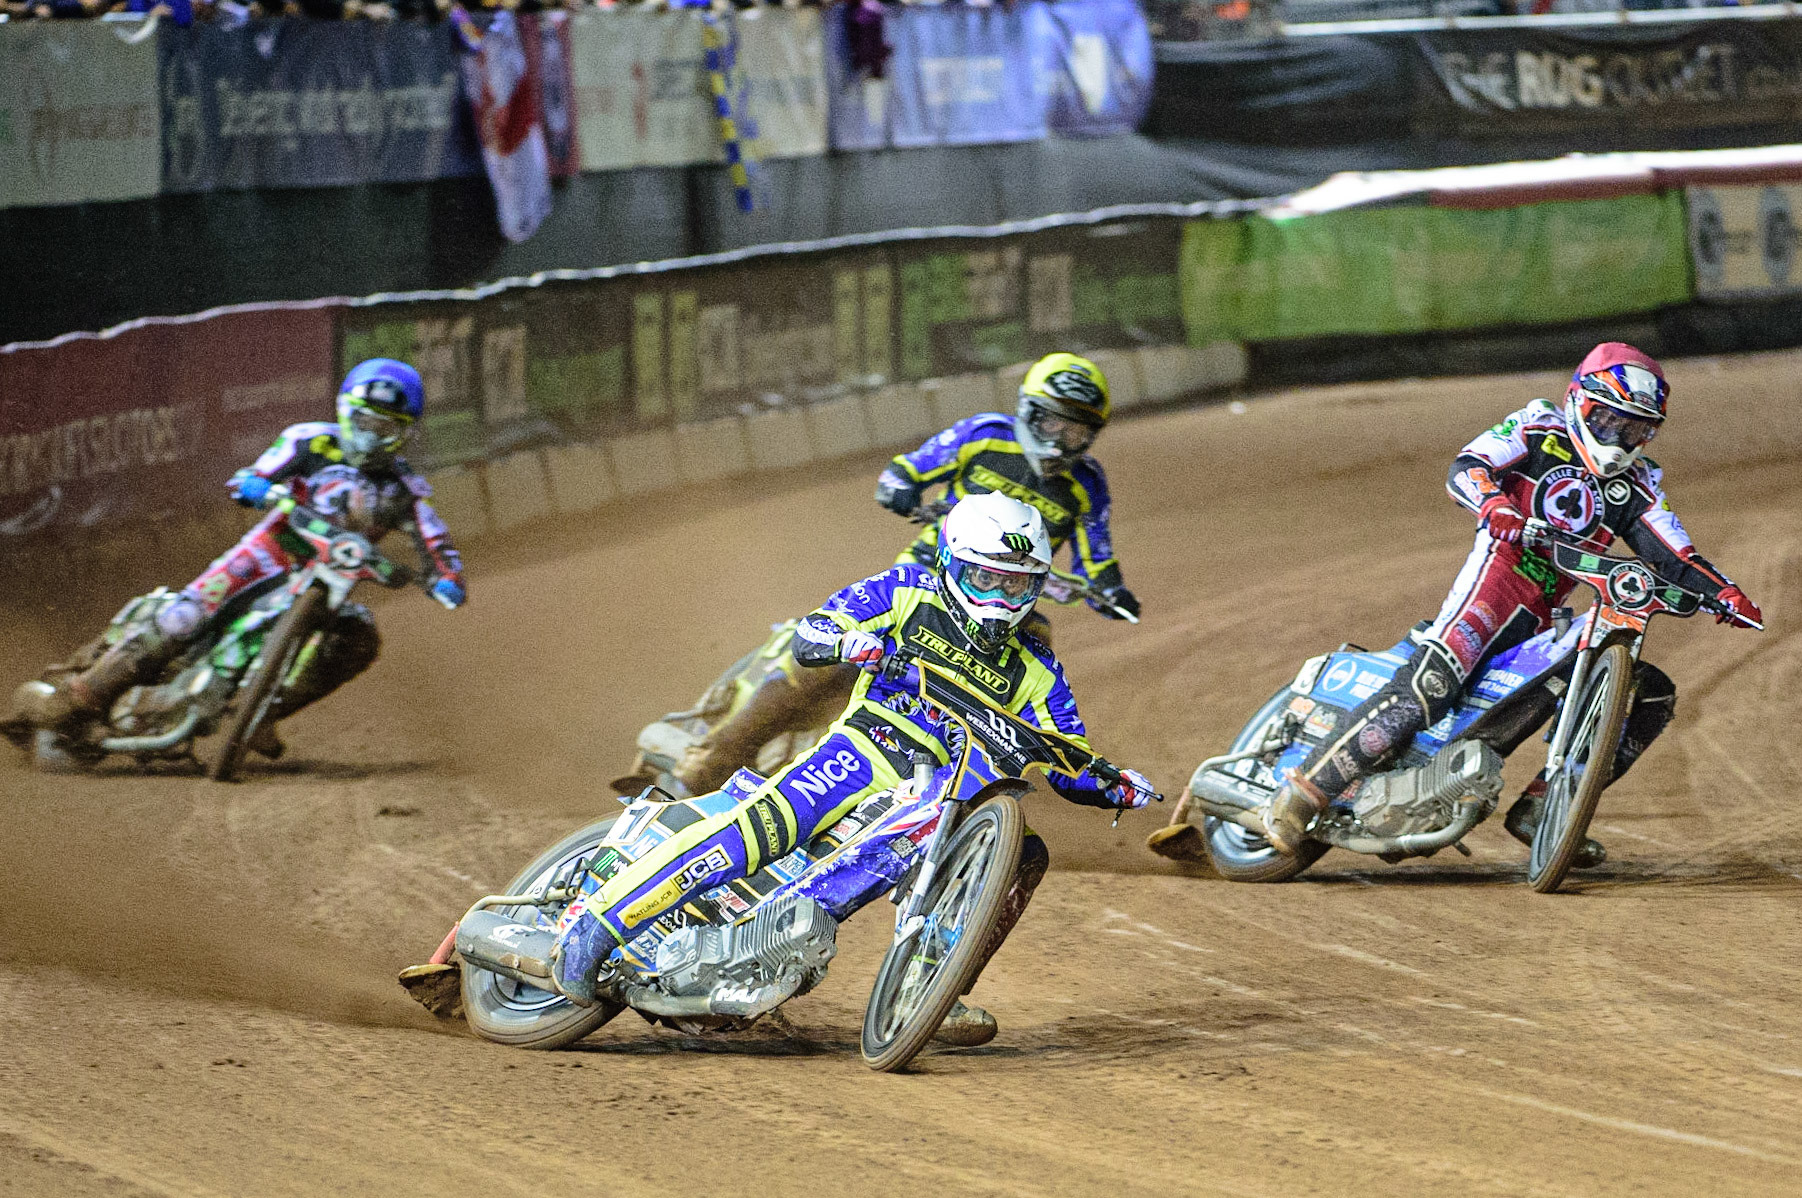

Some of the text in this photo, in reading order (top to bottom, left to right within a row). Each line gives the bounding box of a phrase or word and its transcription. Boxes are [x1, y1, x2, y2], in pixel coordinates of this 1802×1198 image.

[1545, 469, 1572, 485] BELLE
[789, 750, 861, 808] Nice
[618, 805, 651, 840] 1
[680, 851, 727, 890] JCB
[660, 890, 673, 903] JCB
